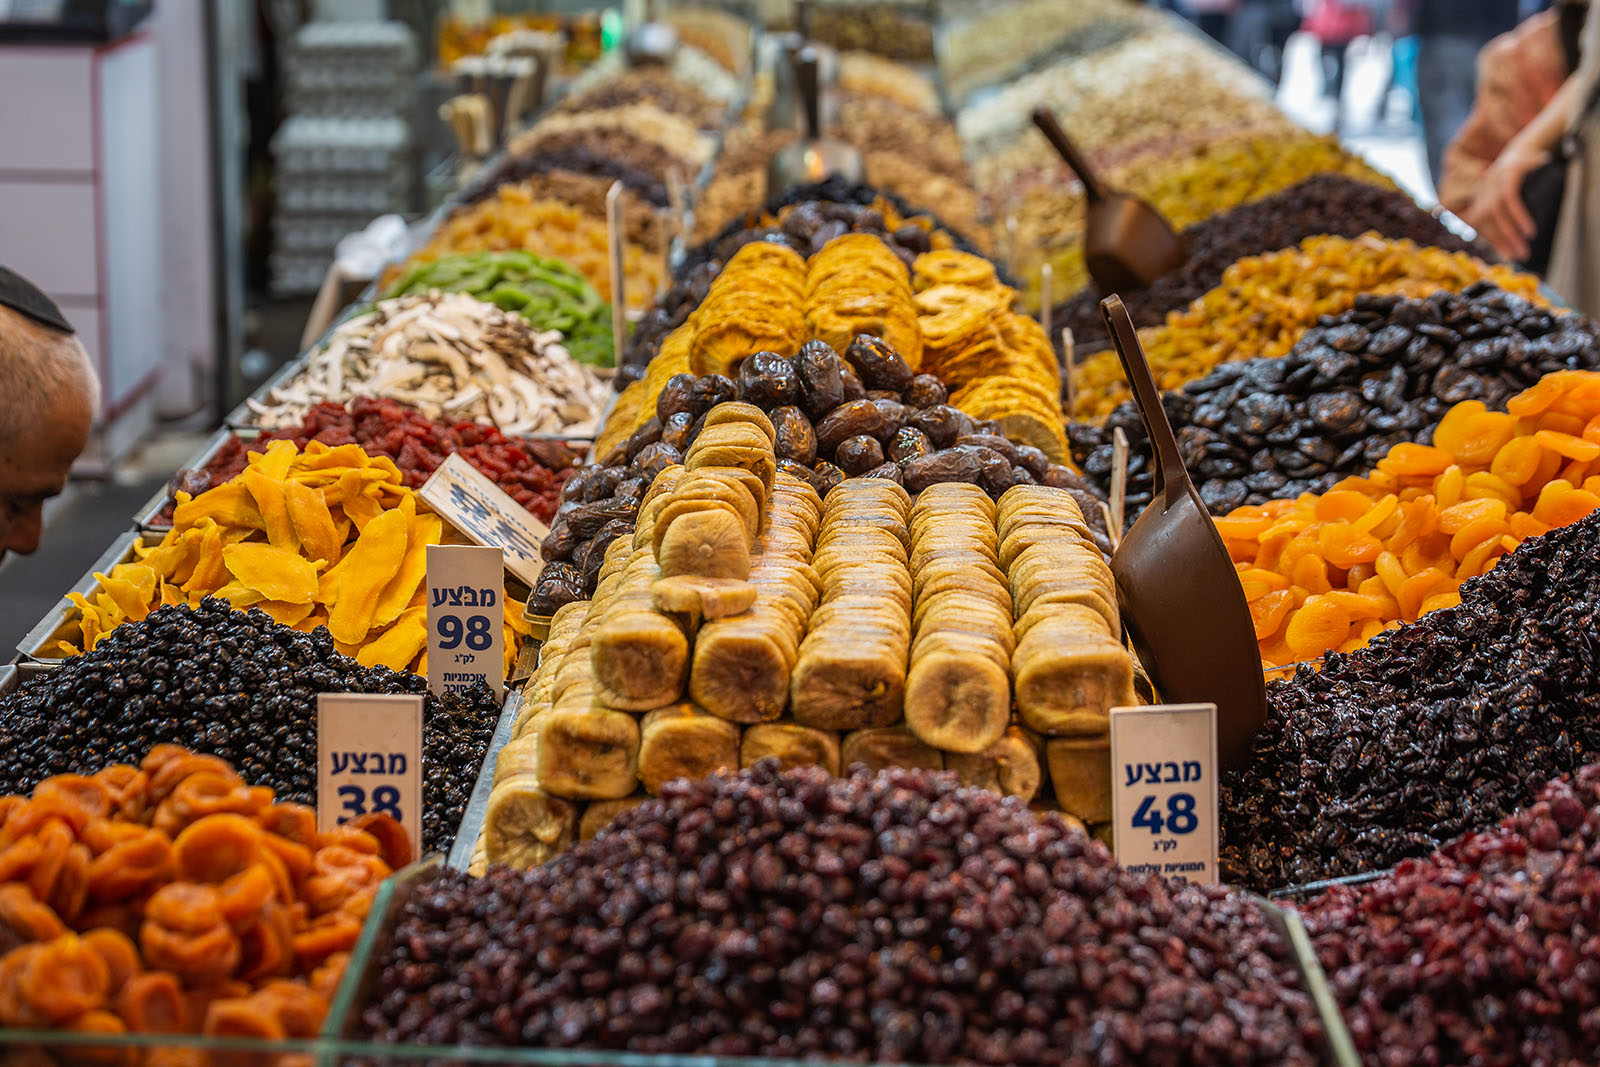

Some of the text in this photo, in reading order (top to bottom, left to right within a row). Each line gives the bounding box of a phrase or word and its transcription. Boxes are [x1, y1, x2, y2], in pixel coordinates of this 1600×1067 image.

[432, 585, 496, 607] מבצע
[437, 615, 493, 651] 98
[454, 653, 475, 665] לק"ג
[443, 672, 487, 682] אוכמניות
[331, 752, 407, 775] מבצע
[1125, 761, 1202, 787] מבצע
[337, 785, 403, 825] 38
[1131, 793, 1198, 835] 48
